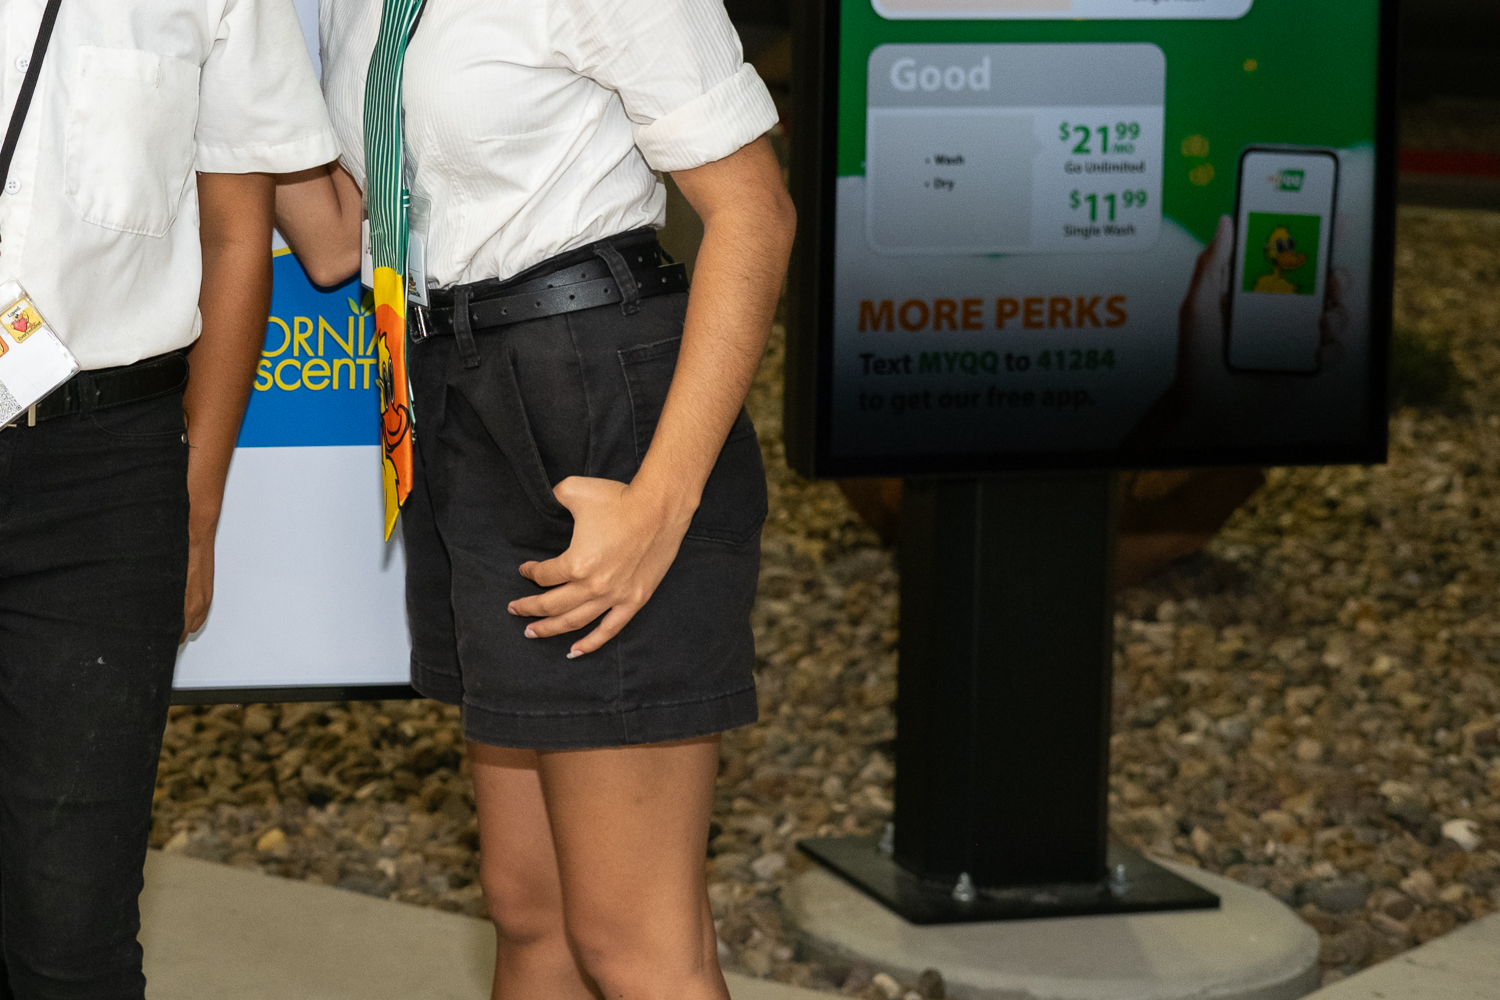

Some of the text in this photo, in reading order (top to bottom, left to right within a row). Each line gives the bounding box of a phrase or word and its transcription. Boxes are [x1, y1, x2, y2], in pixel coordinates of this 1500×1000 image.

[889, 56, 992, 92] Good
[933, 154, 965, 165] Wash
[1064, 161, 1146, 174] Go Unlimited
[933, 177, 956, 191] Dry
[1063, 224, 1136, 239] Single Wash
[858, 295, 1127, 332] MORE PERKS
[858, 348, 1117, 376] Text MYQQ to 41284
[859, 390, 884, 412] to
[890, 390, 932, 416] get
[938, 390, 981, 410] our
[987, 385, 1035, 409] free
